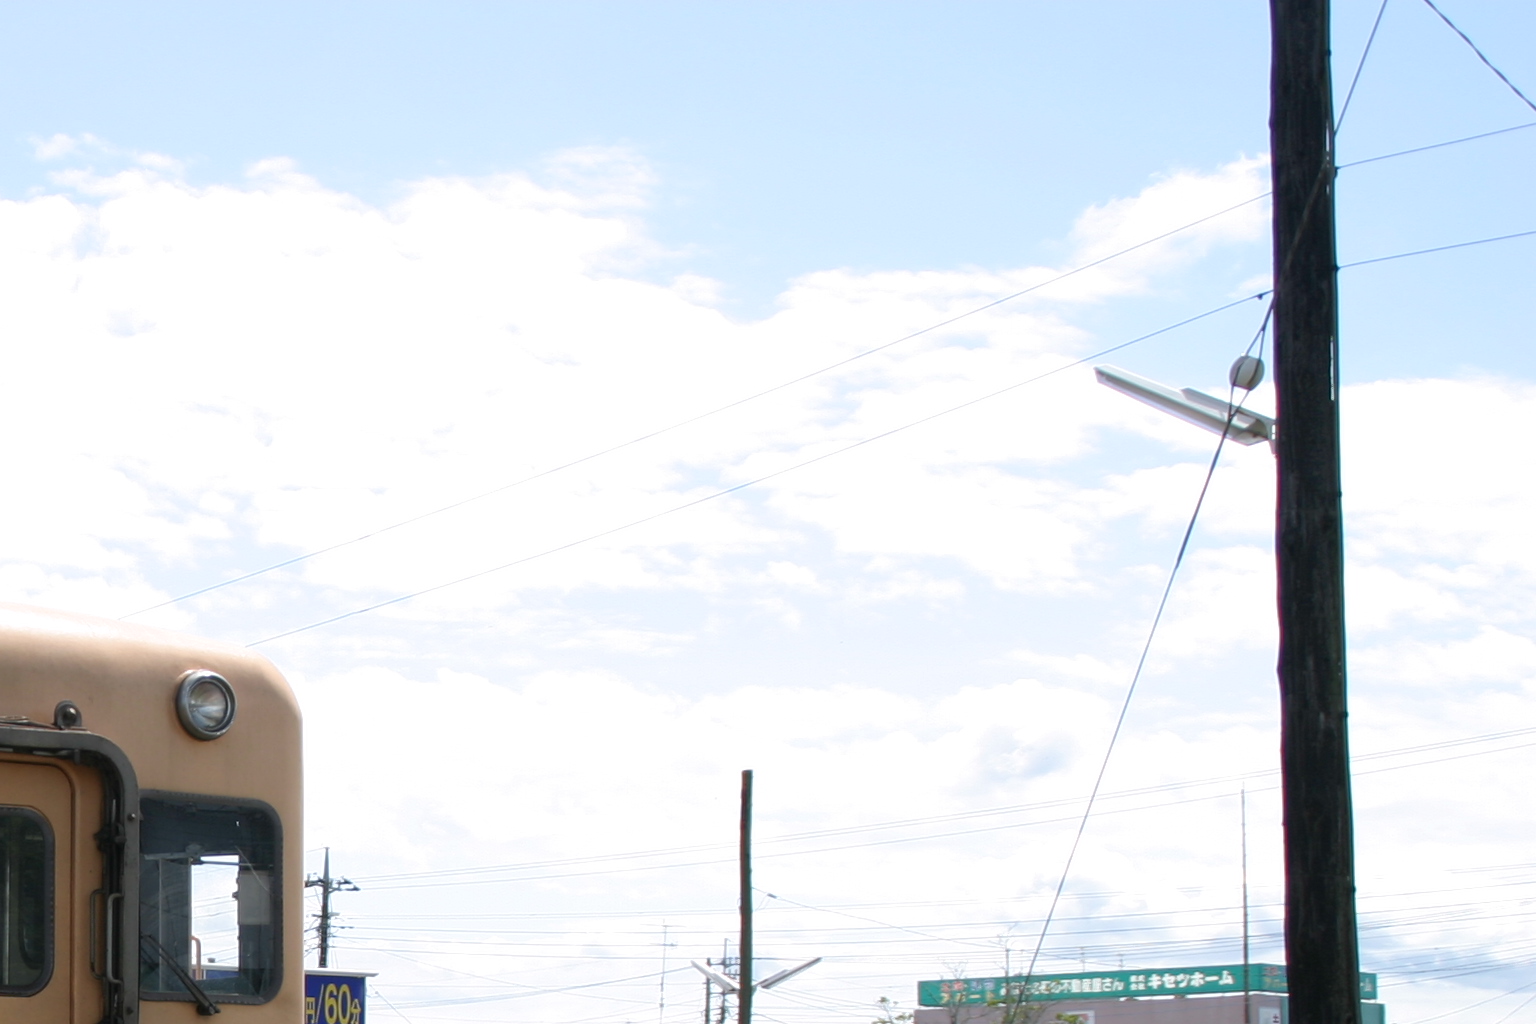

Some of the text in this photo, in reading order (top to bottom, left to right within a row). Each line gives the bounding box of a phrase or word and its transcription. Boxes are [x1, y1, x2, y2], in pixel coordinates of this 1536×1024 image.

[1147, 970, 1235, 989] キセツホーム
